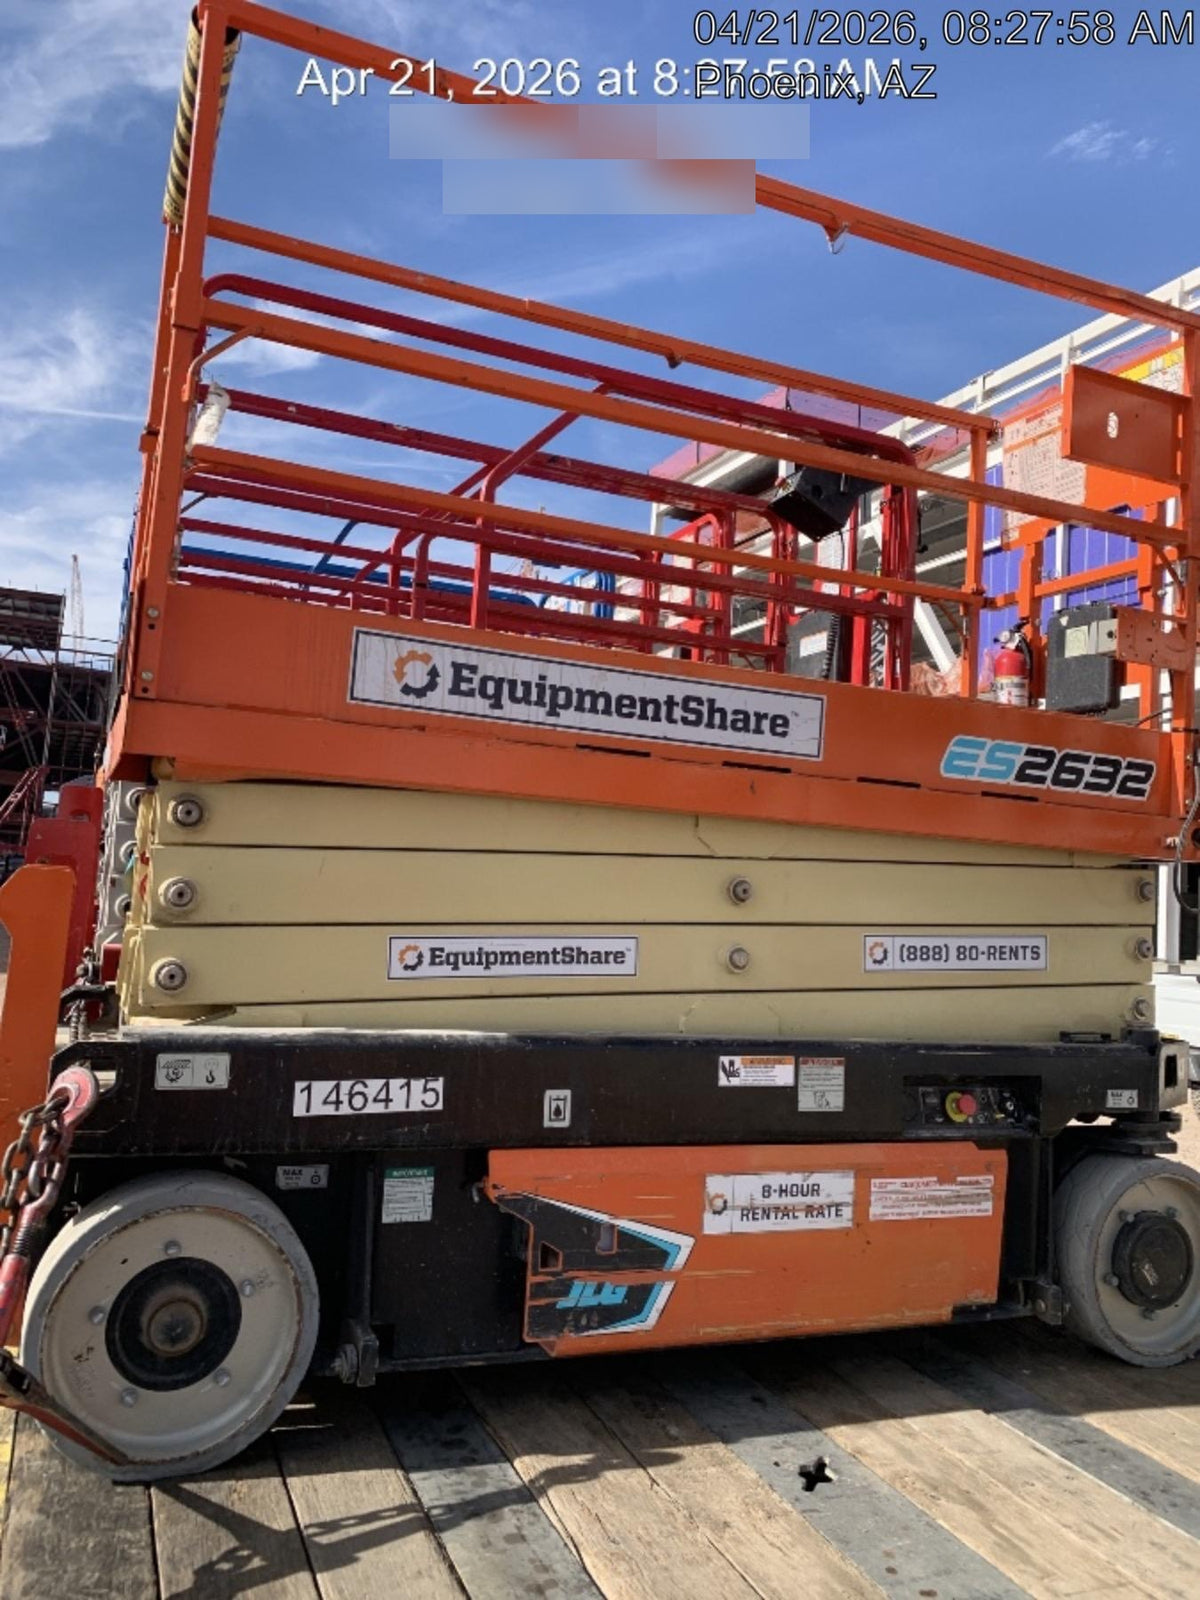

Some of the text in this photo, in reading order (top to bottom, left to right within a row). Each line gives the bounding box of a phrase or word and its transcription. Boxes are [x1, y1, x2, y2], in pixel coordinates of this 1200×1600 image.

[447, 661, 791, 738] EquipmentShare
[940, 734, 1156, 801] ES2632
[428, 946, 627, 971] EquipmentShare
[899, 943, 950, 963] (888)
[299, 1076, 441, 1114] 146415
[740, 1203, 844, 1222] RENTAL RATE
